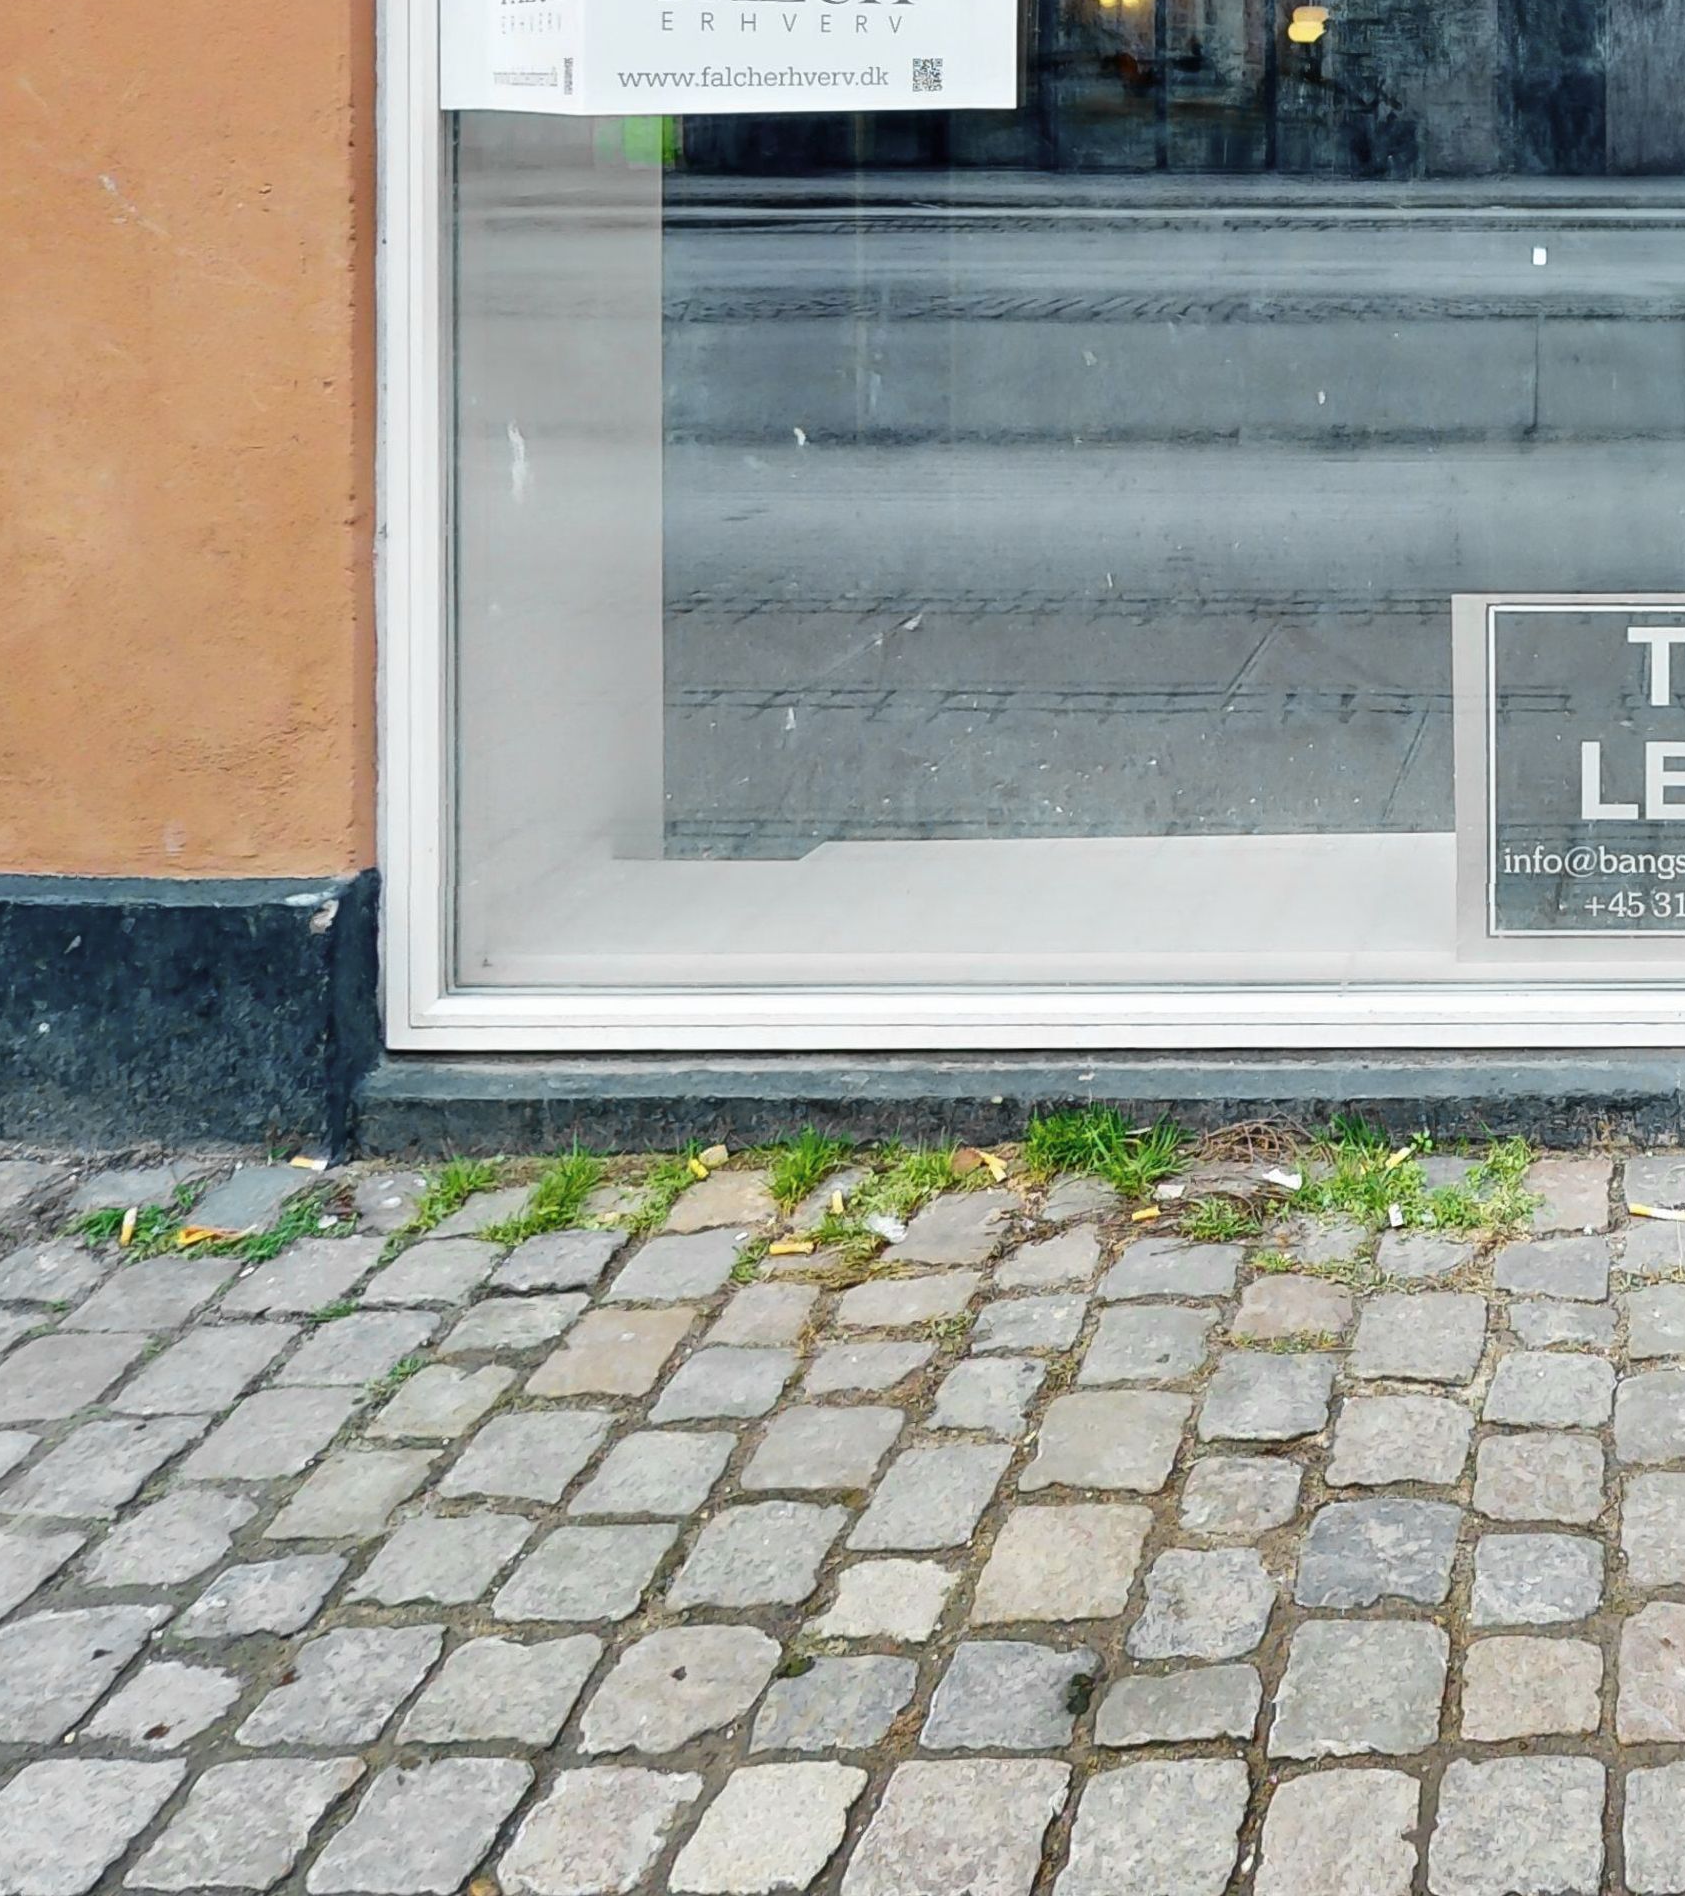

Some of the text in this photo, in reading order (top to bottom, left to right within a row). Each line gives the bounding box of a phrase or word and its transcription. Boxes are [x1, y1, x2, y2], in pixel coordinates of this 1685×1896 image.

[661, 11, 903, 33] ERHVERV
[617, 66, 890, 88] www.falcherhverv.dk
[1584, 891, 1644, 918] +45
